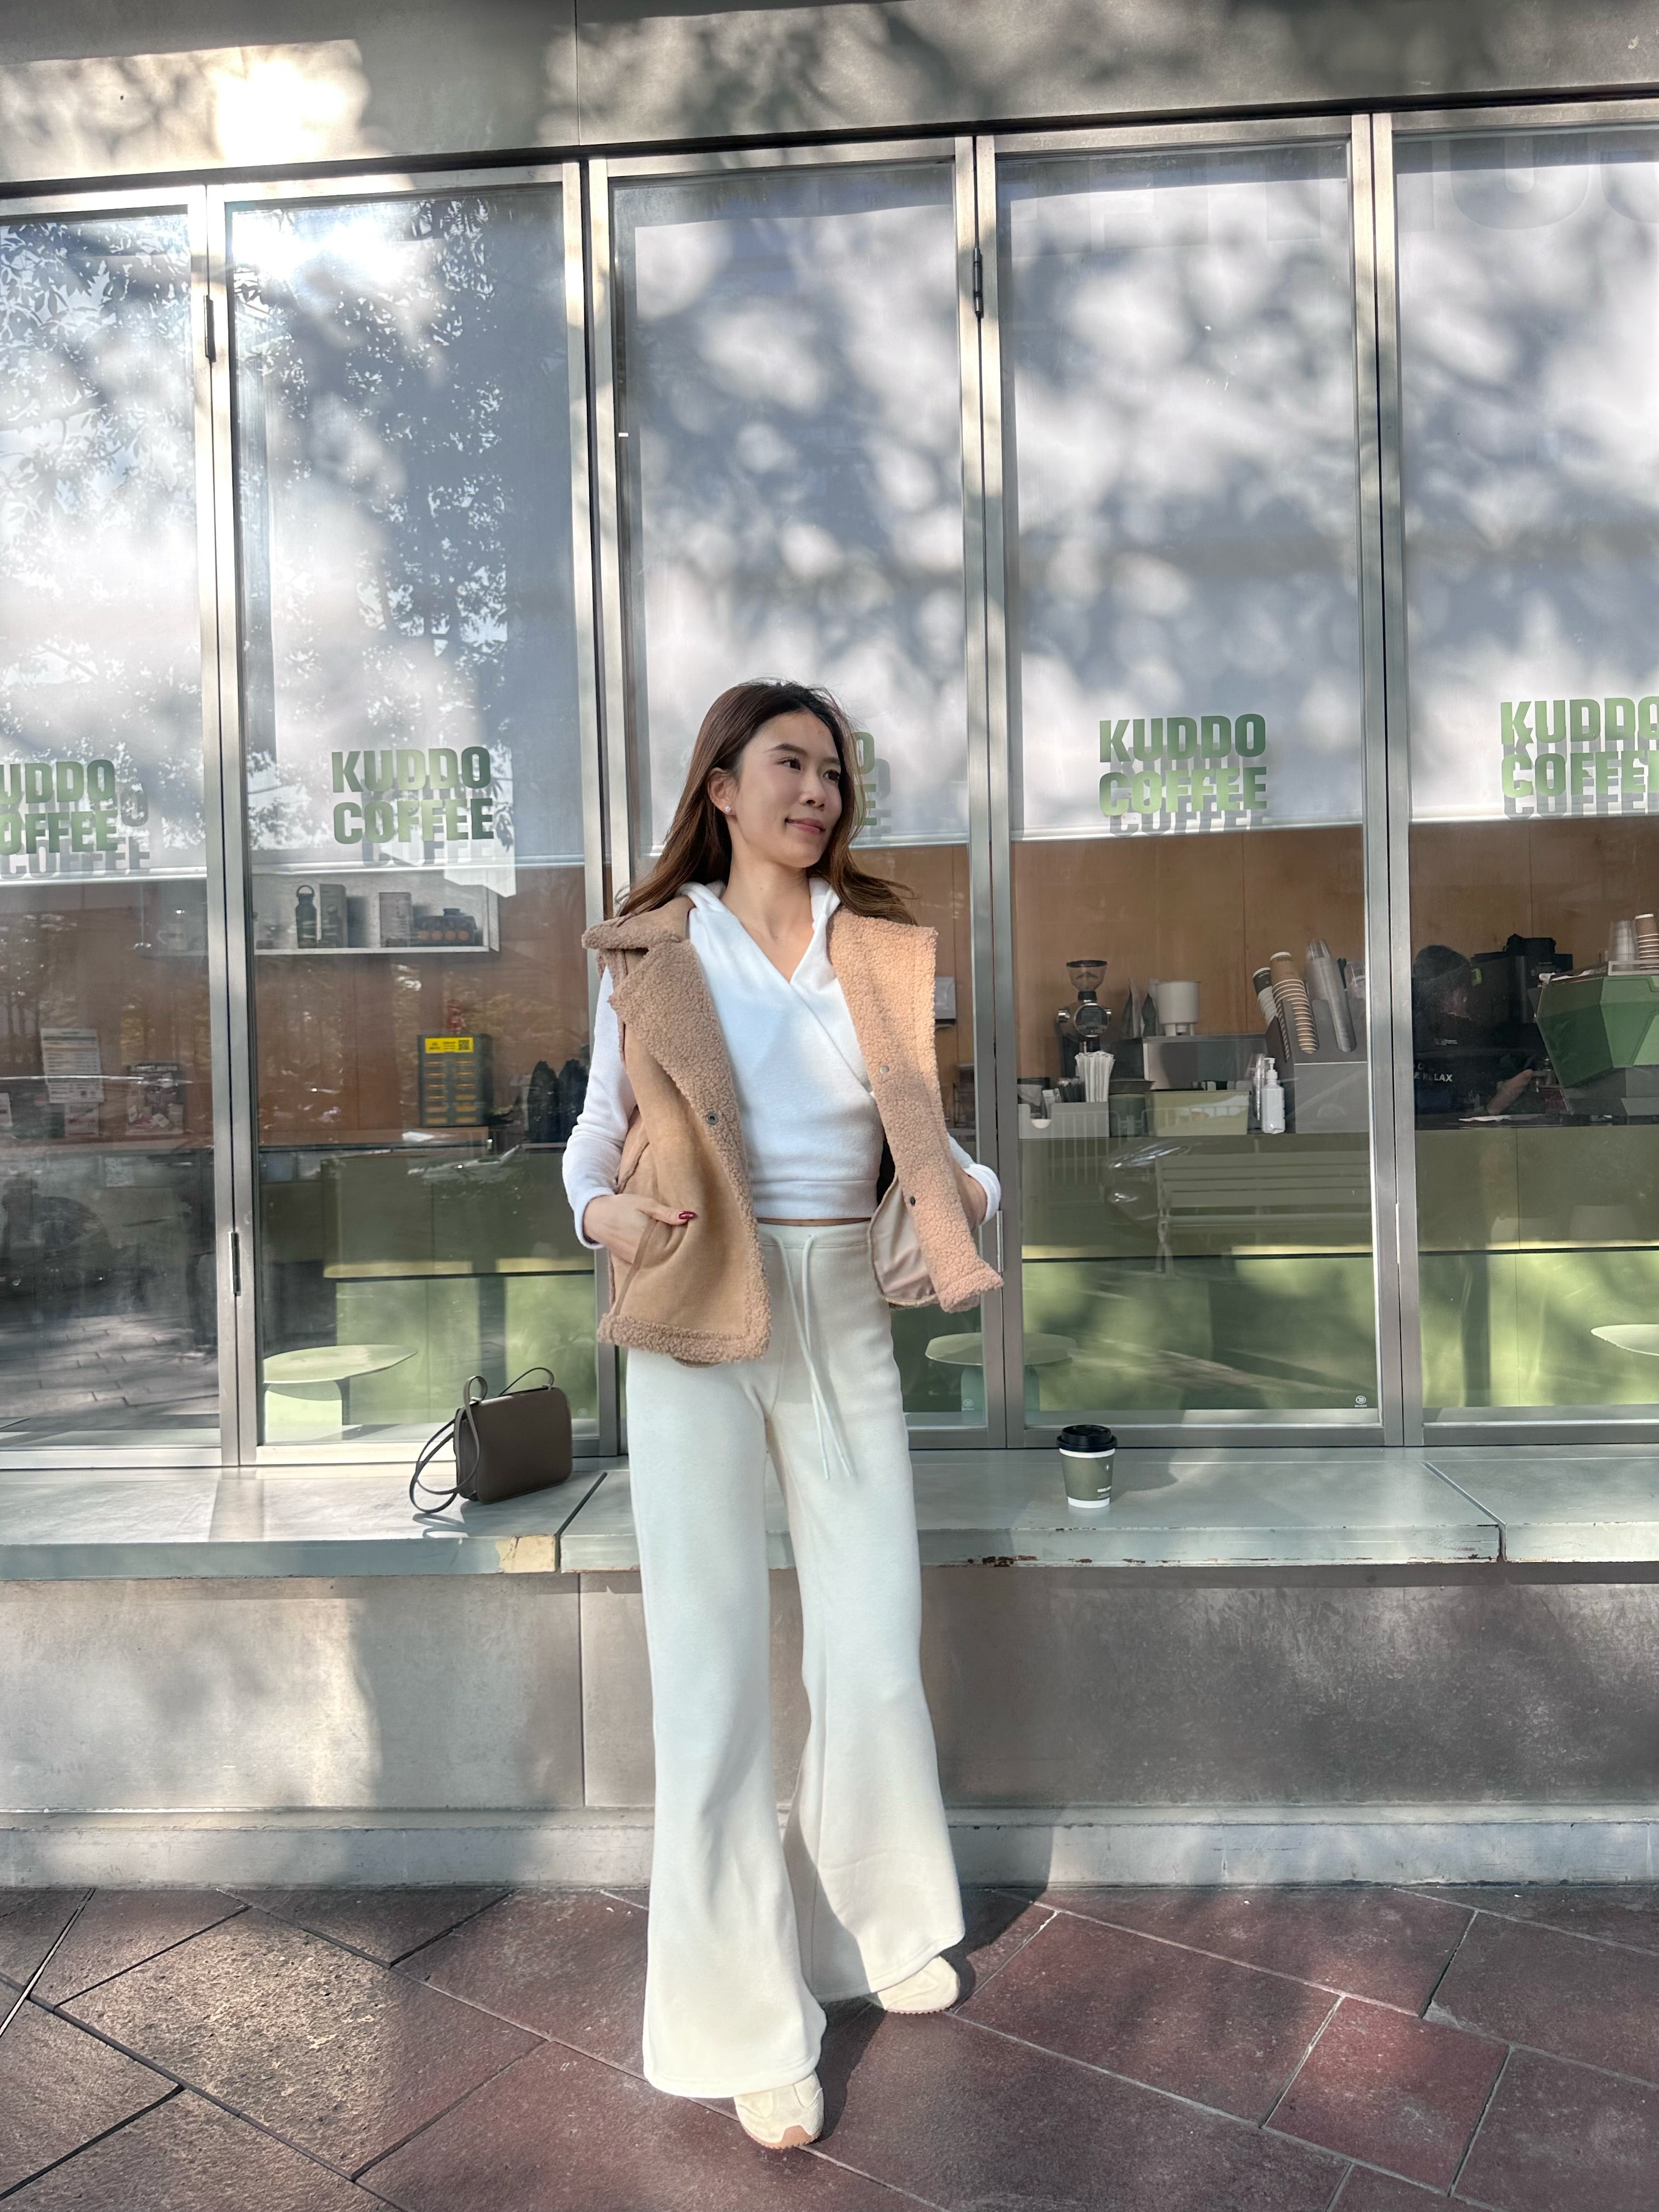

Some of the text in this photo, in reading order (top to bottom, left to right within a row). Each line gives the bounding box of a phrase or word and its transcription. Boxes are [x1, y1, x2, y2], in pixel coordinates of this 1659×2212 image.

[1099, 714, 1266, 763] KUDDO
[1500, 696, 1659, 744] KUDDO
[0, 759, 115, 805] UDDO
[331, 746, 491, 793] KUDDO
[1099, 766, 1267, 816] COFFEE
[0, 810, 118, 856] OFFEE
[334, 798, 494, 844] COFFEE
